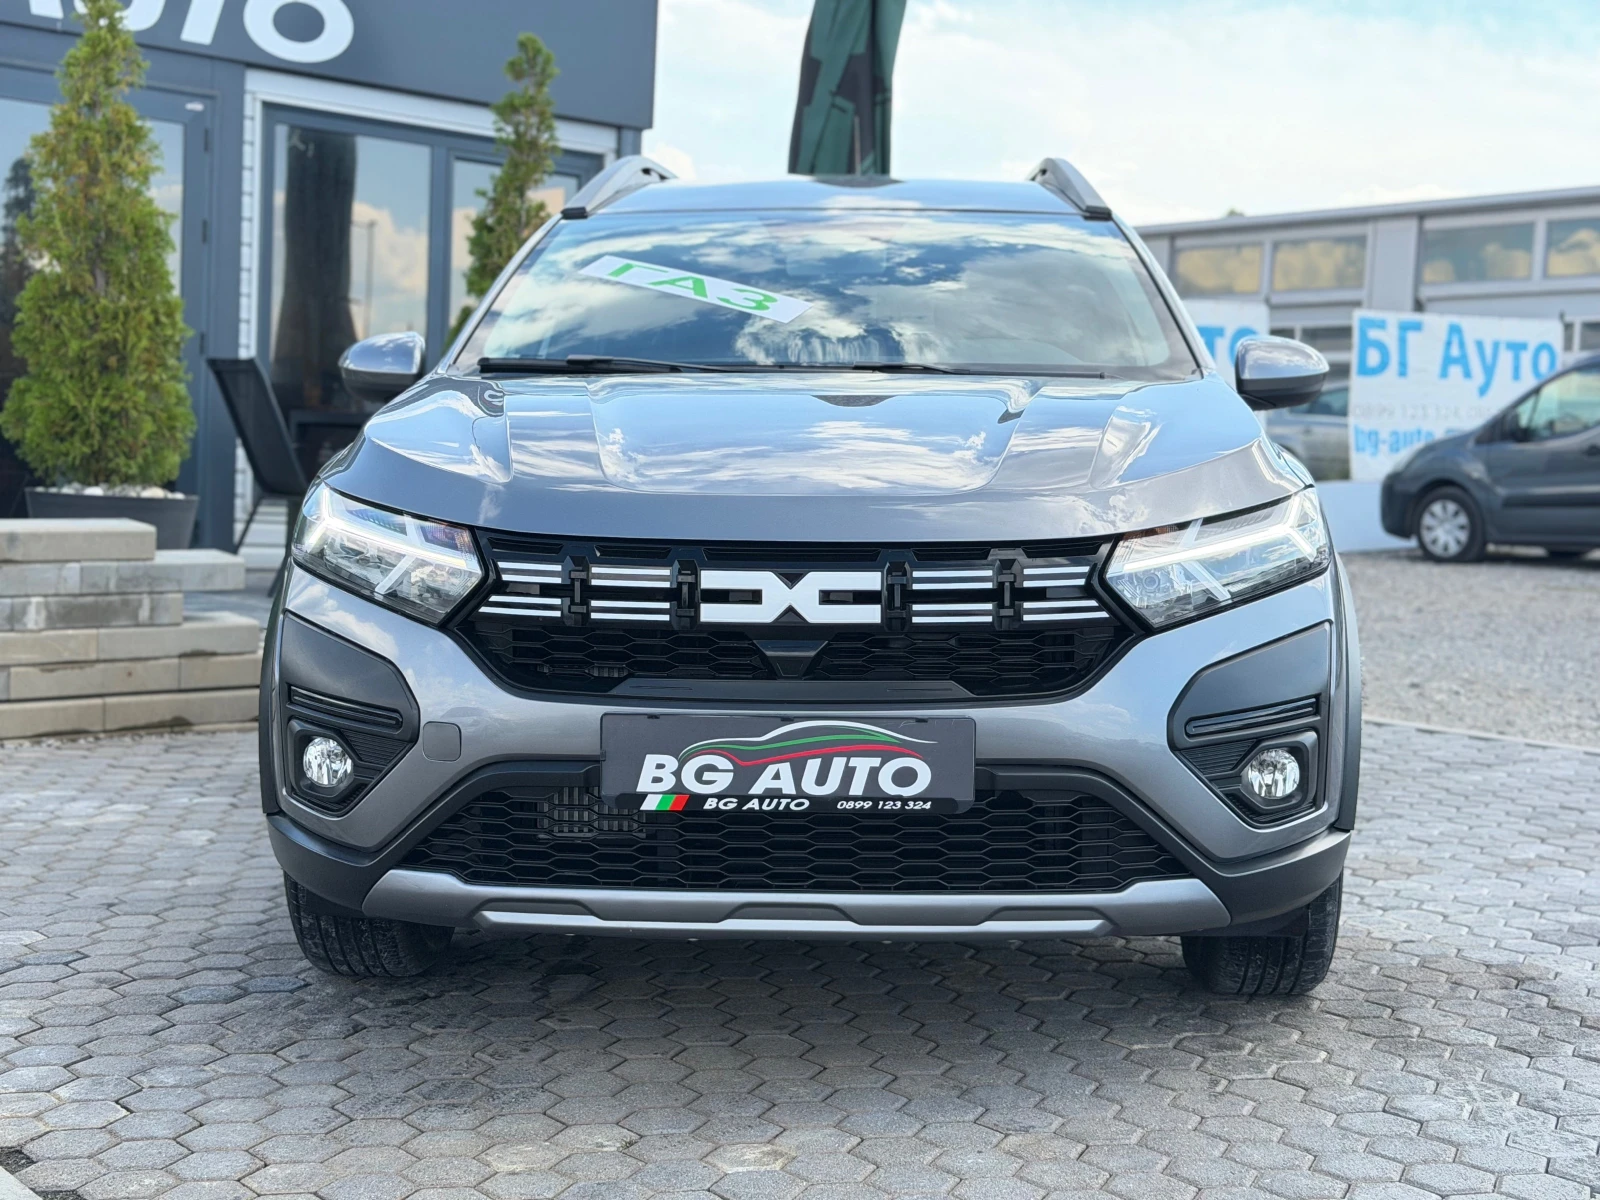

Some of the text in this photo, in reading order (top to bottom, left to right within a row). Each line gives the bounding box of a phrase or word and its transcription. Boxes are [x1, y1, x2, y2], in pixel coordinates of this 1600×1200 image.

[1356, 316, 1558, 398] БГ Ауто
[636, 754, 932, 797] BG AUTO
[703, 797, 932, 811] BG AUTO 0899 123 324
